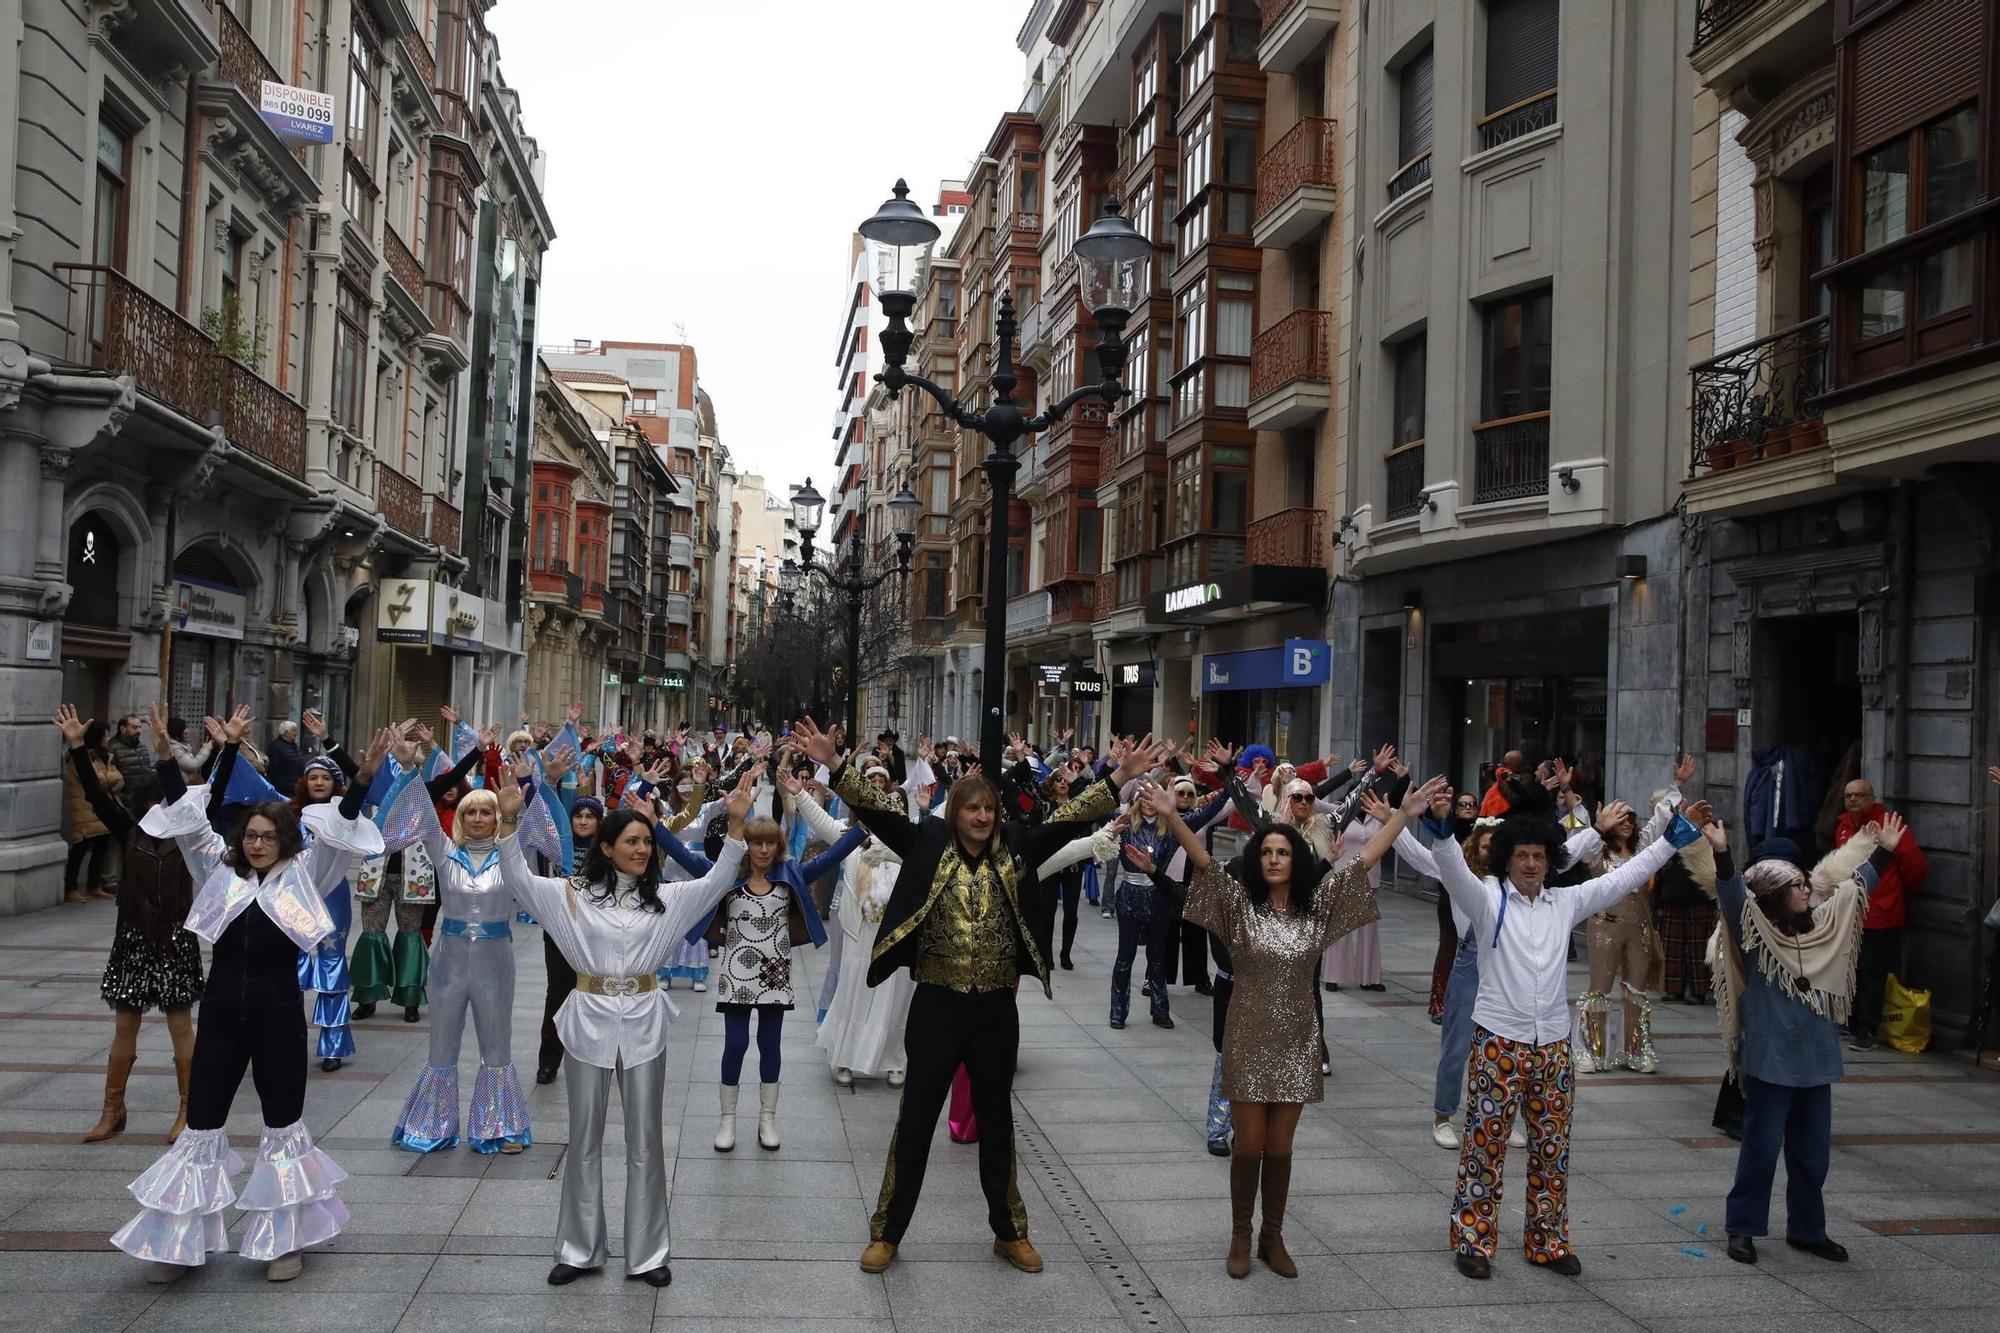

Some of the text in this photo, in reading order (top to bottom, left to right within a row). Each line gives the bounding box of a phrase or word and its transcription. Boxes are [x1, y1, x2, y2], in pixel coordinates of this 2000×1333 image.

[264, 84, 331, 109] DISPONIBLE
[263, 99, 331, 122] 985 099 099
[1293, 649, 1312, 676] B
[664, 678, 684, 687] 11:11
[1123, 664, 1139, 683] TOUS
[1074, 681, 1101, 692] TOUS
